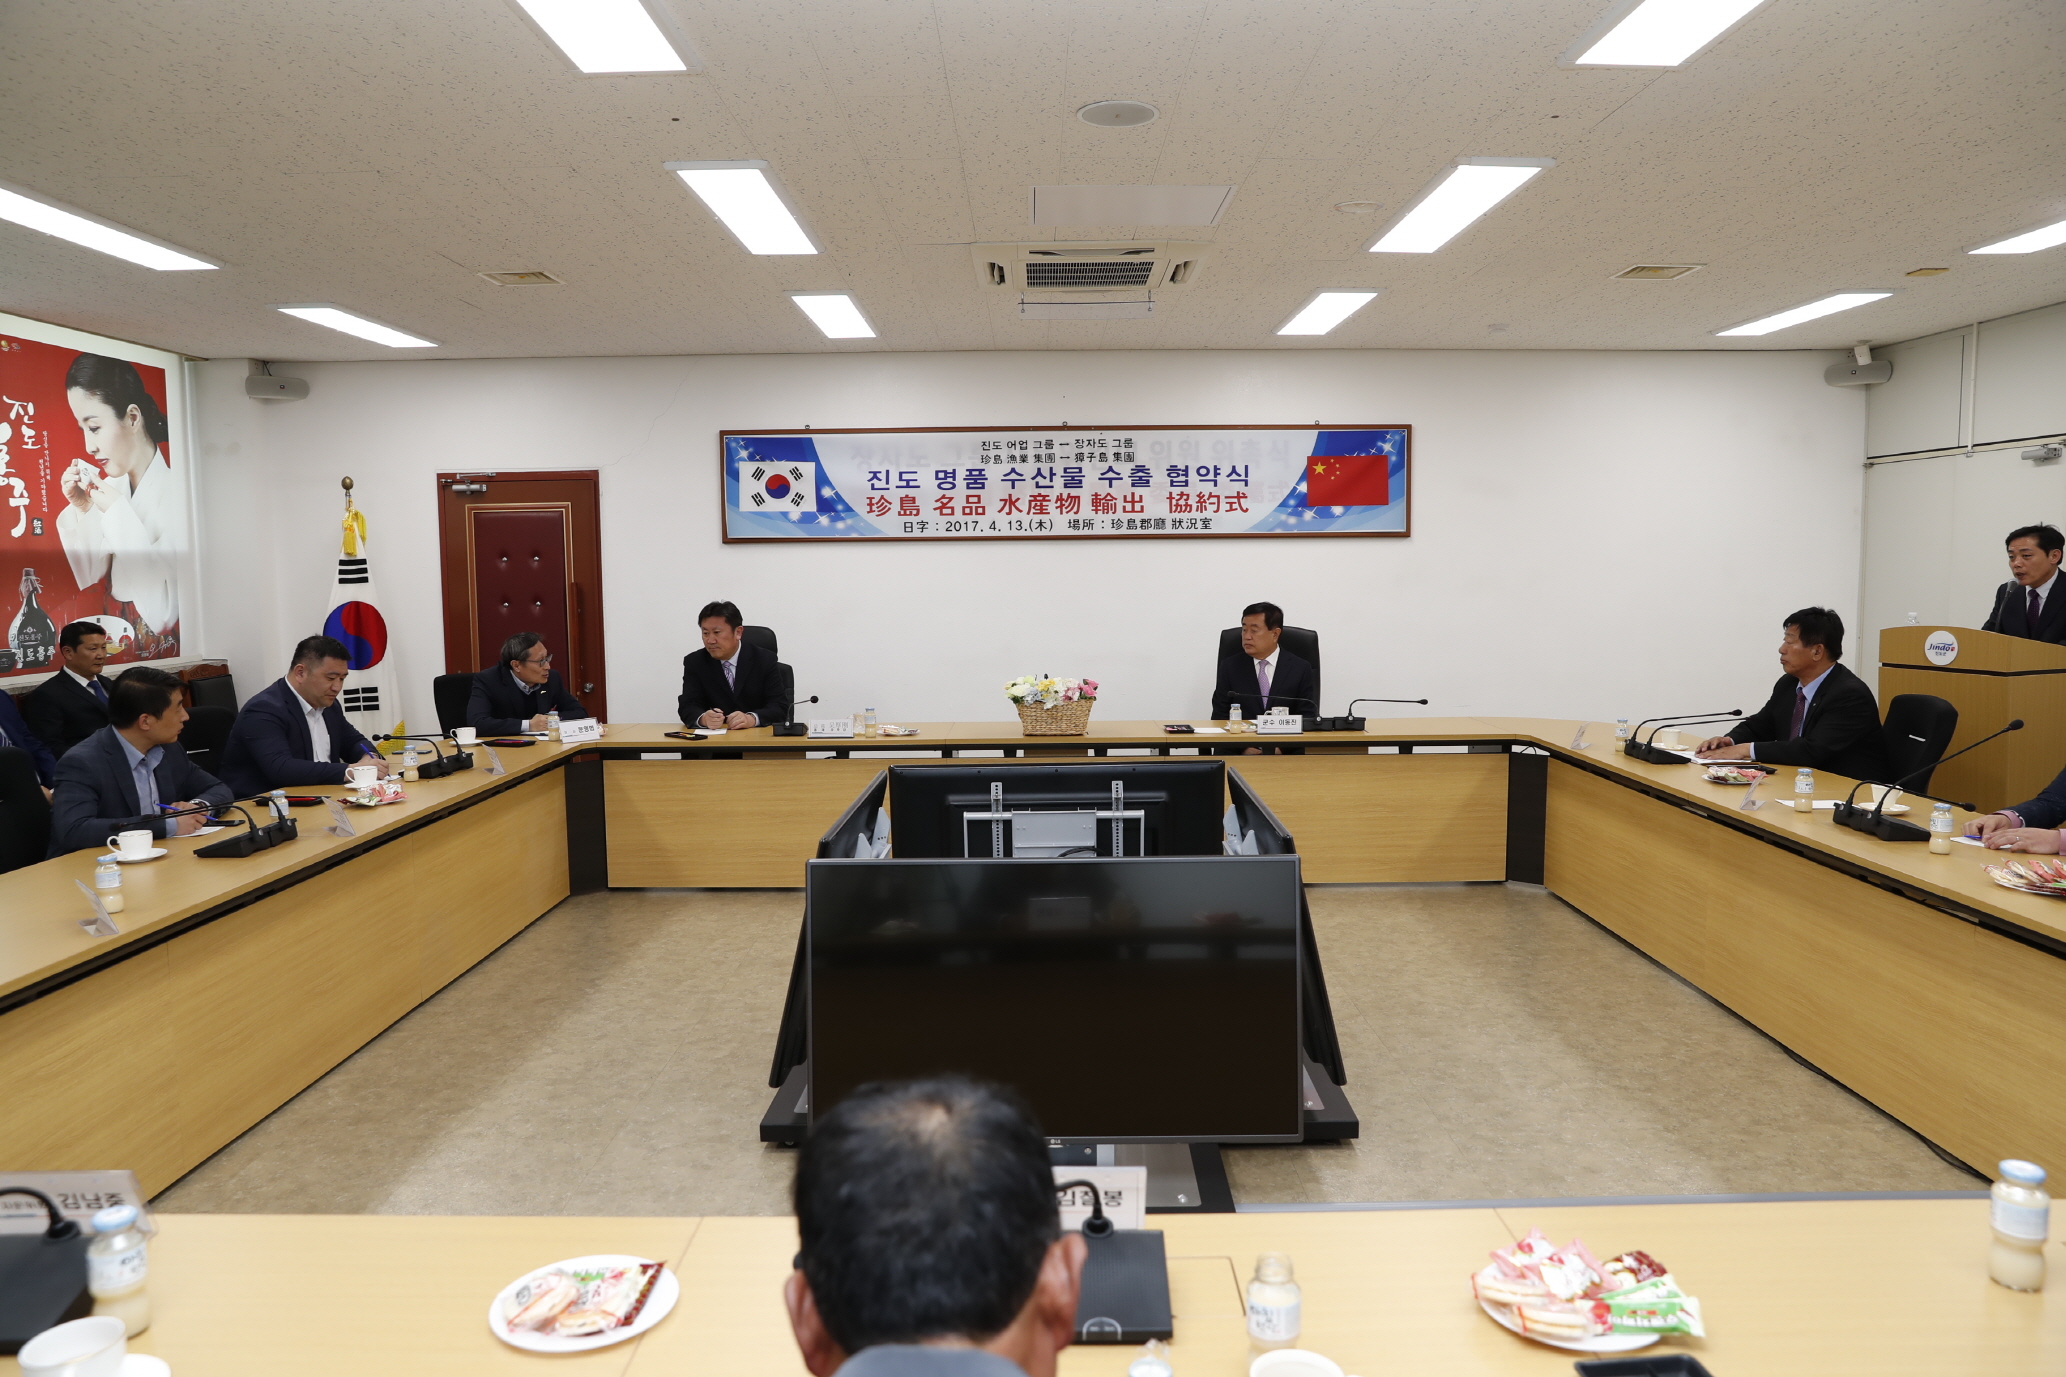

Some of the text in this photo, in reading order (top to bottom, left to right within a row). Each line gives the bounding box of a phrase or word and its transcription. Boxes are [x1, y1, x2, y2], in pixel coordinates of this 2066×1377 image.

[981, 438, 1134, 451] 진도 어업 그룹 장자도 그룹
[981, 454, 1003, 464] 珍島
[1006, 453, 1029, 464] 漁業
[1033, 452, 1056, 463] 集團
[1112, 452, 1135, 462] 集團
[867, 464, 1249, 491] 진도 명품 수산물 수출 협약식
[866, 494, 921, 517] 珍島
[933, 493, 986, 517] 名品
[1091, 491, 1145, 514] 輸出
[1166, 491, 1249, 514] 協約式
[903, 520, 929, 533] 日字
[945, 520, 984, 532] 2017.
[988, 520, 1001, 532] 4.
[1067, 518, 1095, 531] 場所
[1262, 718, 1275, 726] 군수
